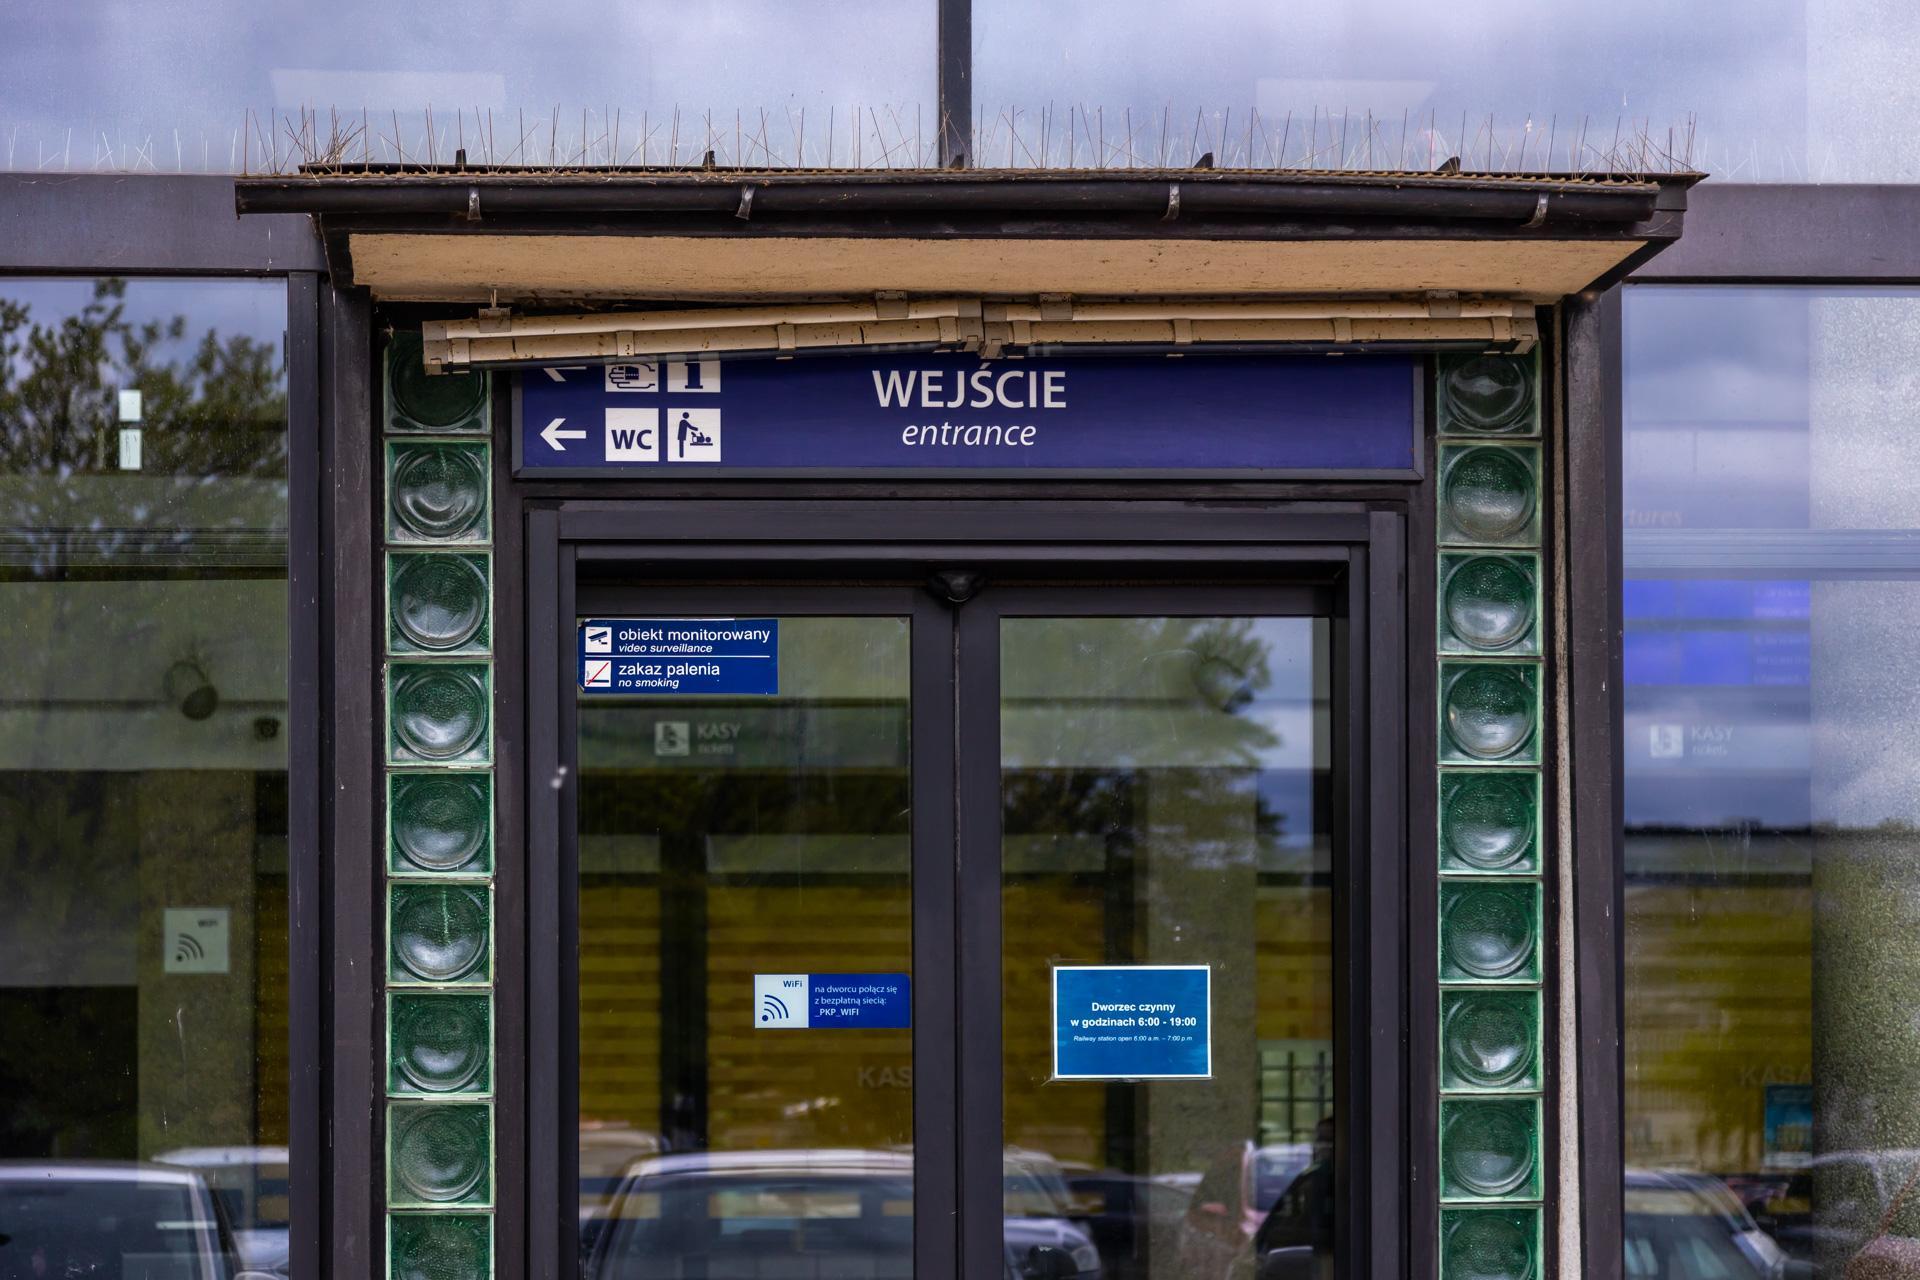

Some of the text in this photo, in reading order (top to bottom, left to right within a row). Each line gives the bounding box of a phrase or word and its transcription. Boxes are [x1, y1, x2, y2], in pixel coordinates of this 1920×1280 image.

[872, 362, 1066, 408] WEJŚCIE
[902, 421, 1037, 446] entrance
[611, 429, 652, 450] WC
[619, 628, 770, 643] obiekt monitorowany
[619, 643, 713, 653] video surveillance
[618, 662, 720, 677] zakaz palenia
[618, 678, 679, 689] no smoking
[697, 722, 741, 739] KASY
[783, 980, 803, 988] WiFi
[826, 985, 857, 993] dworcu
[858, 985, 885, 995] połącz
[886, 985, 898, 995] się
[821, 996, 861, 1006] bezpłatną
[862, 996, 887, 1006] siecią:
[814, 1008, 859, 1018] _PKP_WIFI
[1091, 1002, 1176, 1014] Dworzec czynny
[1070, 1018, 1080, 1026] w
[1082, 1017, 1135, 1028] godzinach
[1138, 1017, 1160, 1027] 6:00
[1170, 1017, 1197, 1027] 19:00
[1073, 1035, 1096, 1043] Railway
